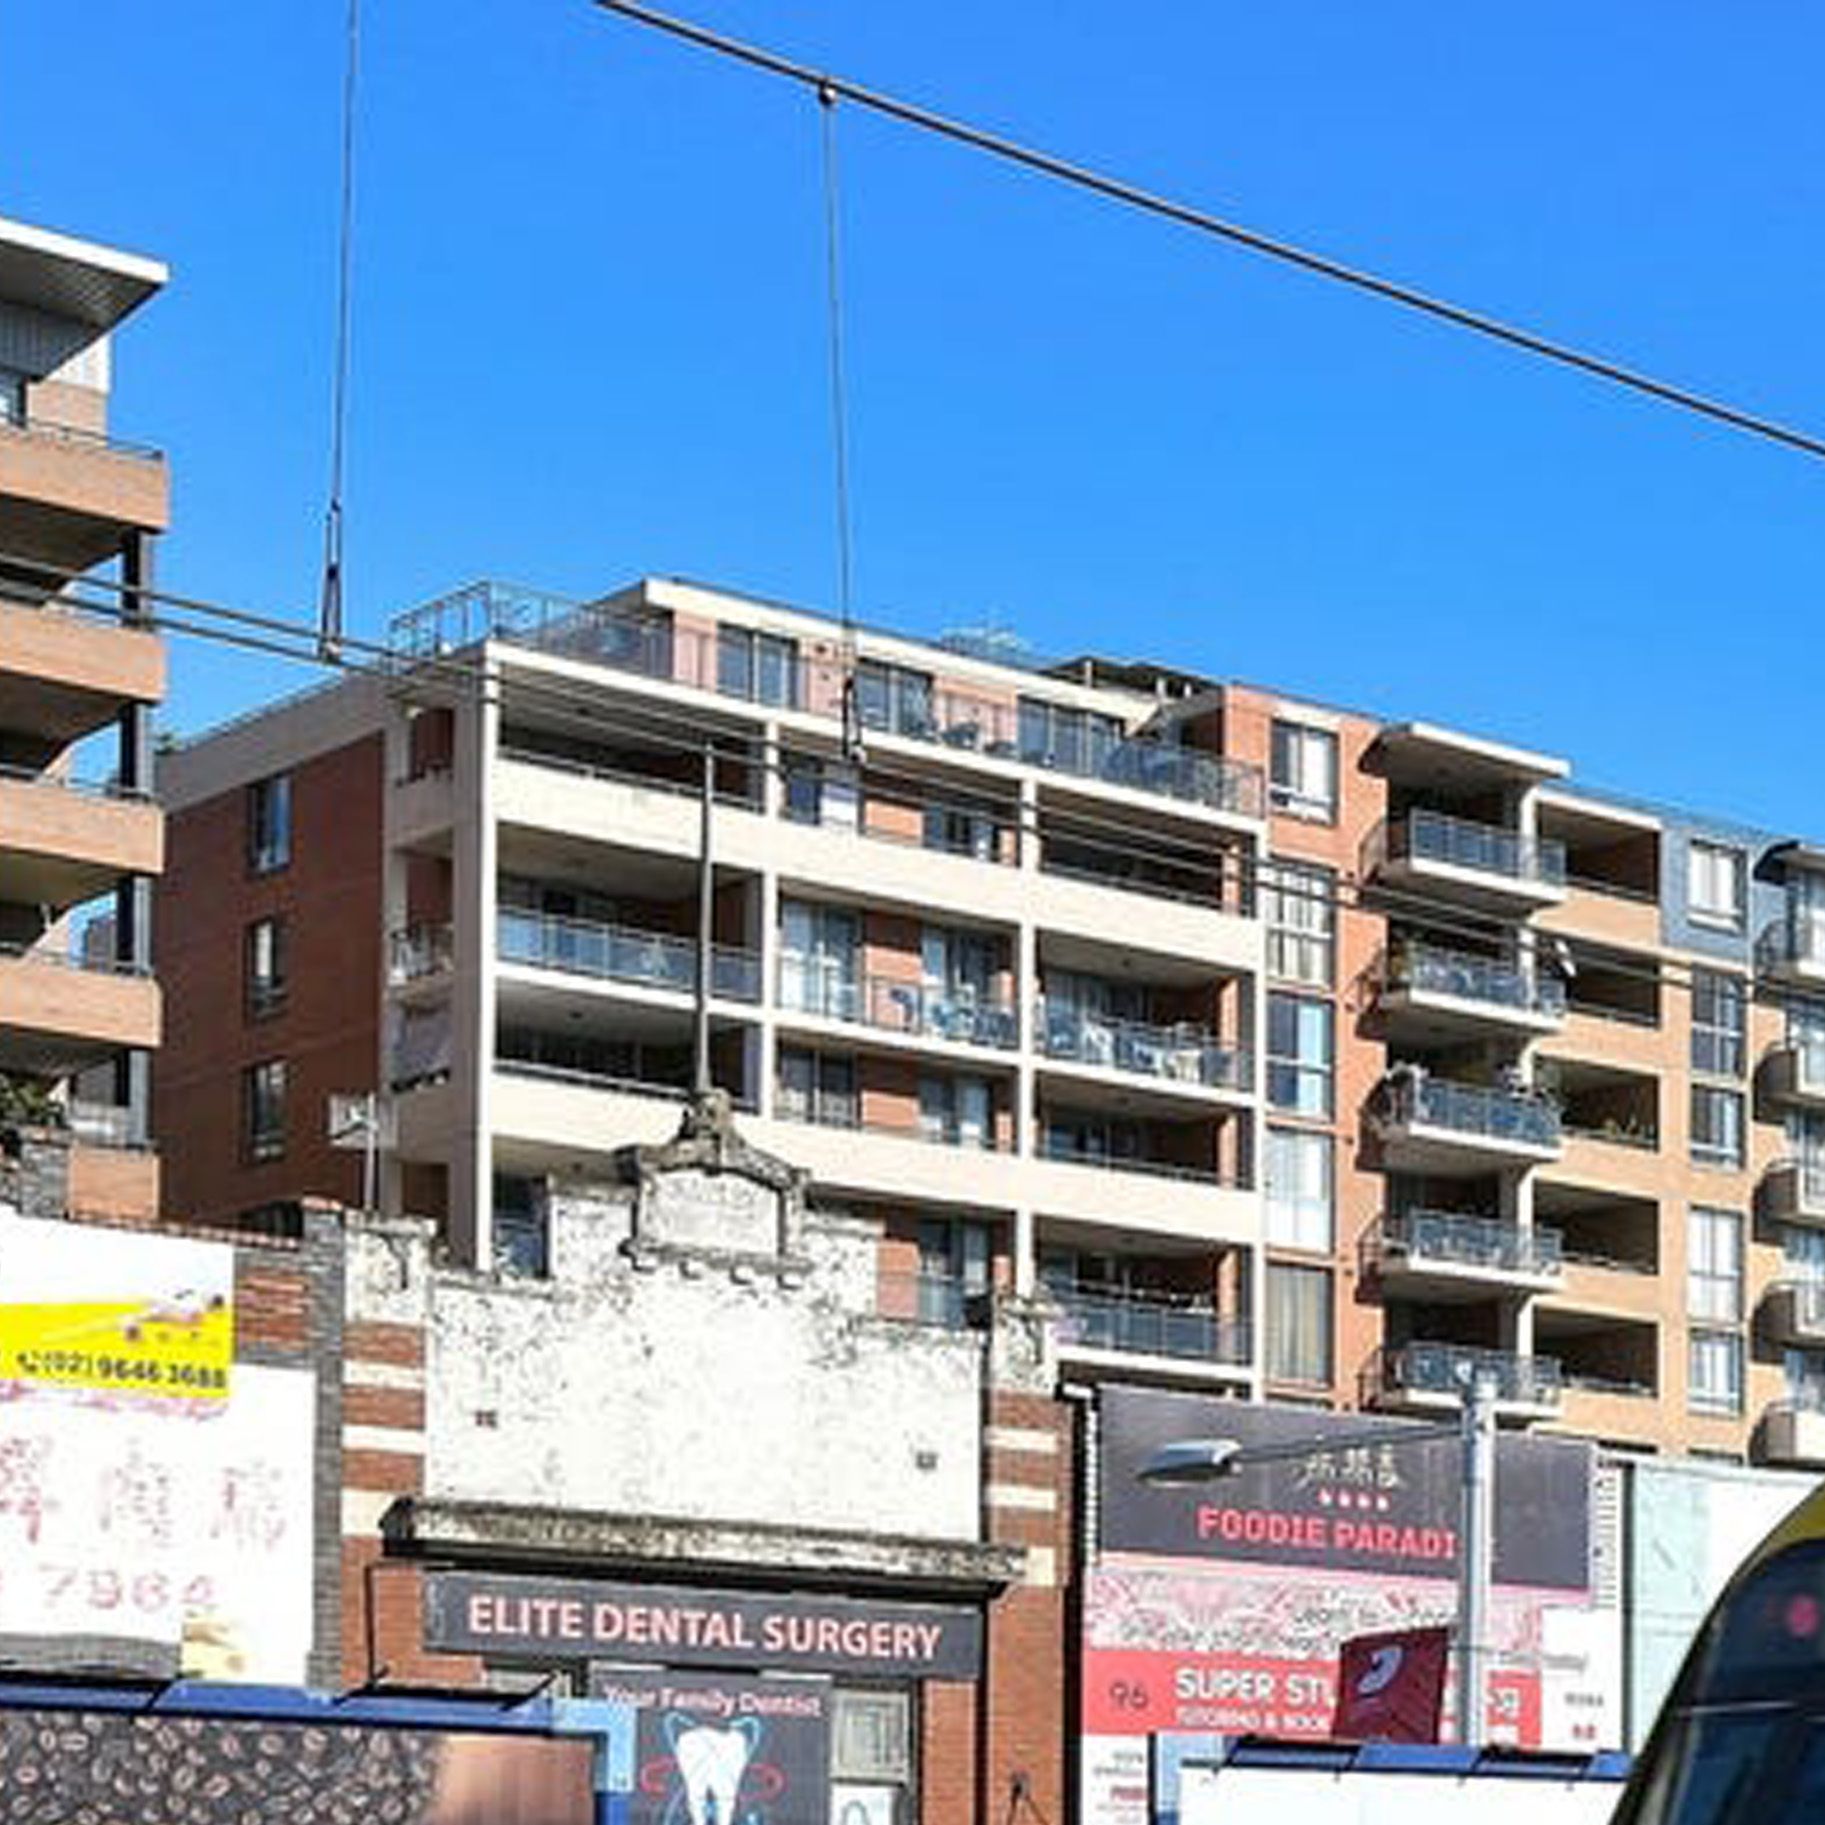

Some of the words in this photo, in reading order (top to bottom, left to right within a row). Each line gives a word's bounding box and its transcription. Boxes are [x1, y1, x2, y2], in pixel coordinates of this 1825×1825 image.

[1196, 1503, 1327, 1549] FOODIE
[468, 1594, 584, 1638] ELITE
[593, 1602, 754, 1648] DENTAL
[762, 1615, 943, 1660] SURGERY
[1175, 1667, 1274, 1703] SUPER
